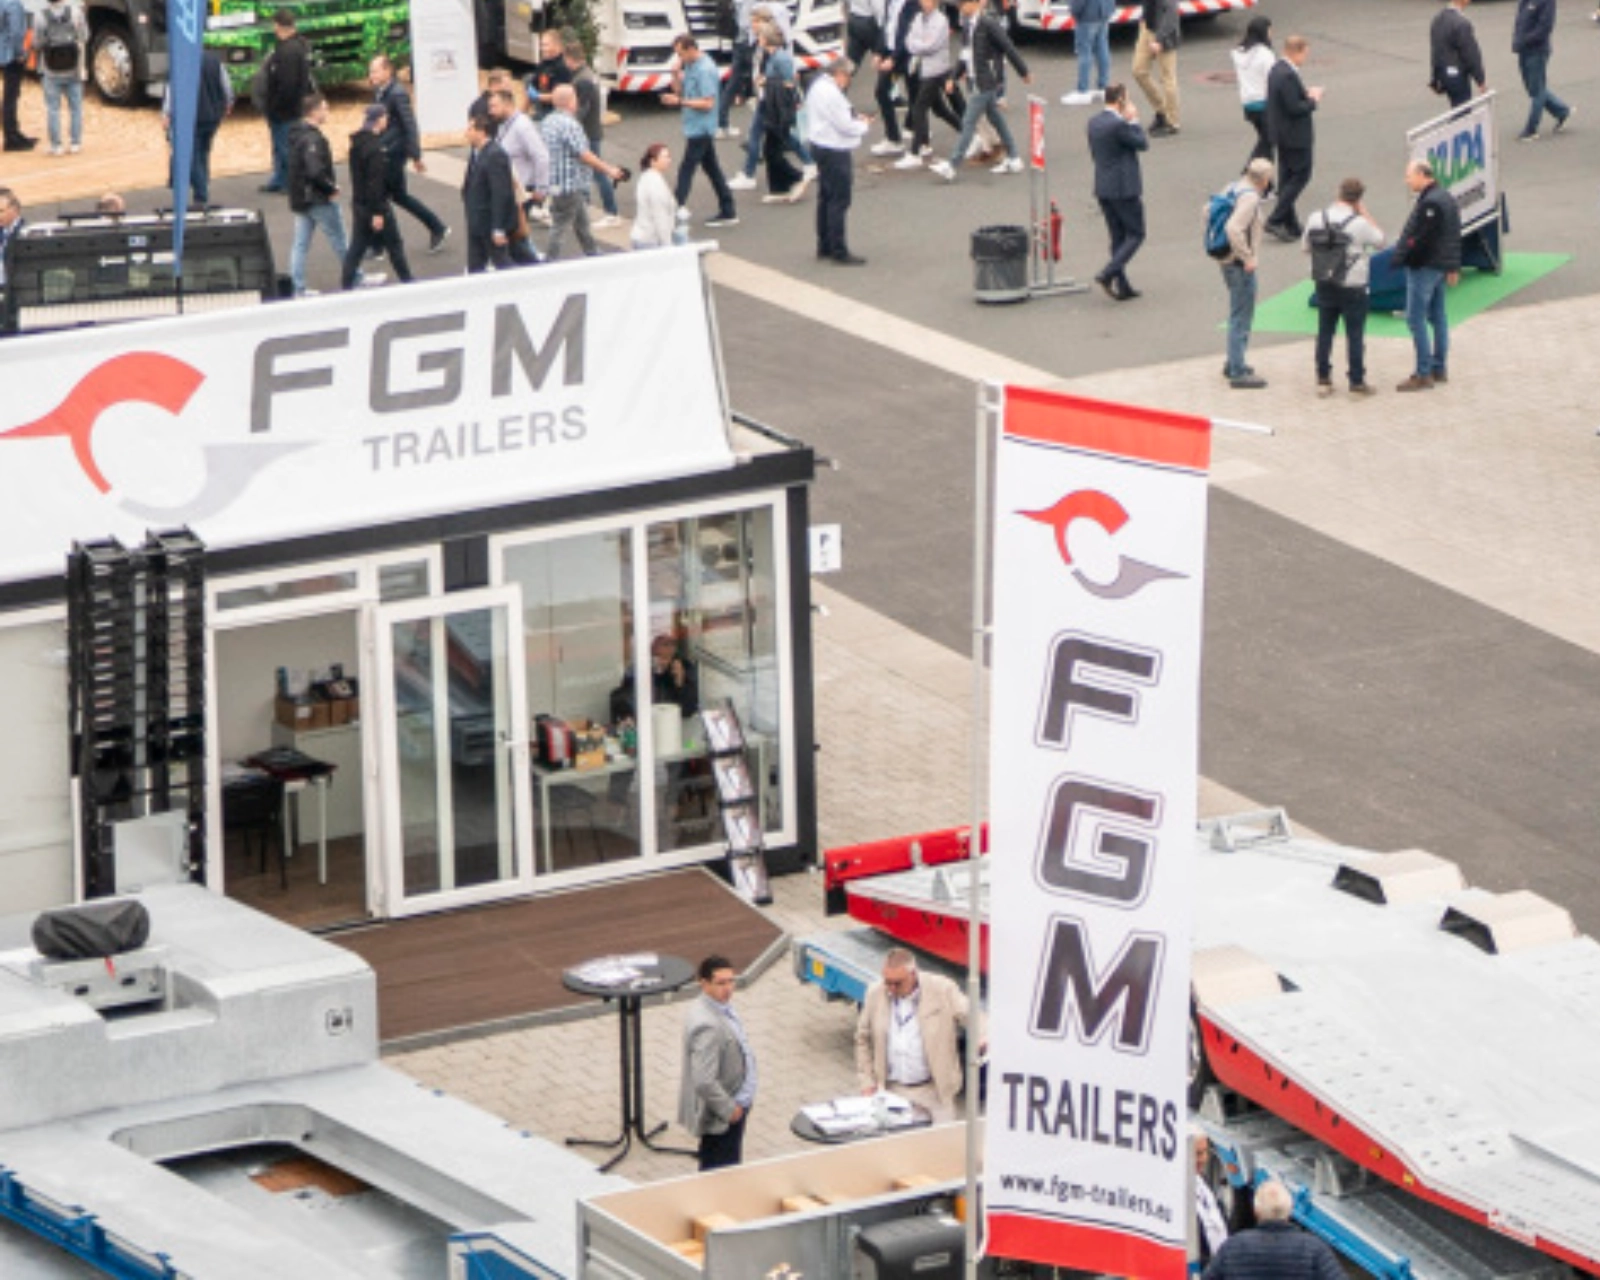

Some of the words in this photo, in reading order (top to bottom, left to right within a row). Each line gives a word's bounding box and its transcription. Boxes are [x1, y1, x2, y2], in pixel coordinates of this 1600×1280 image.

[249, 292, 589, 434] FGM
[362, 405, 589, 472] TRAILERS
[1032, 630, 1164, 1056] FGM
[1002, 1072, 1179, 1162] TRAILERS
